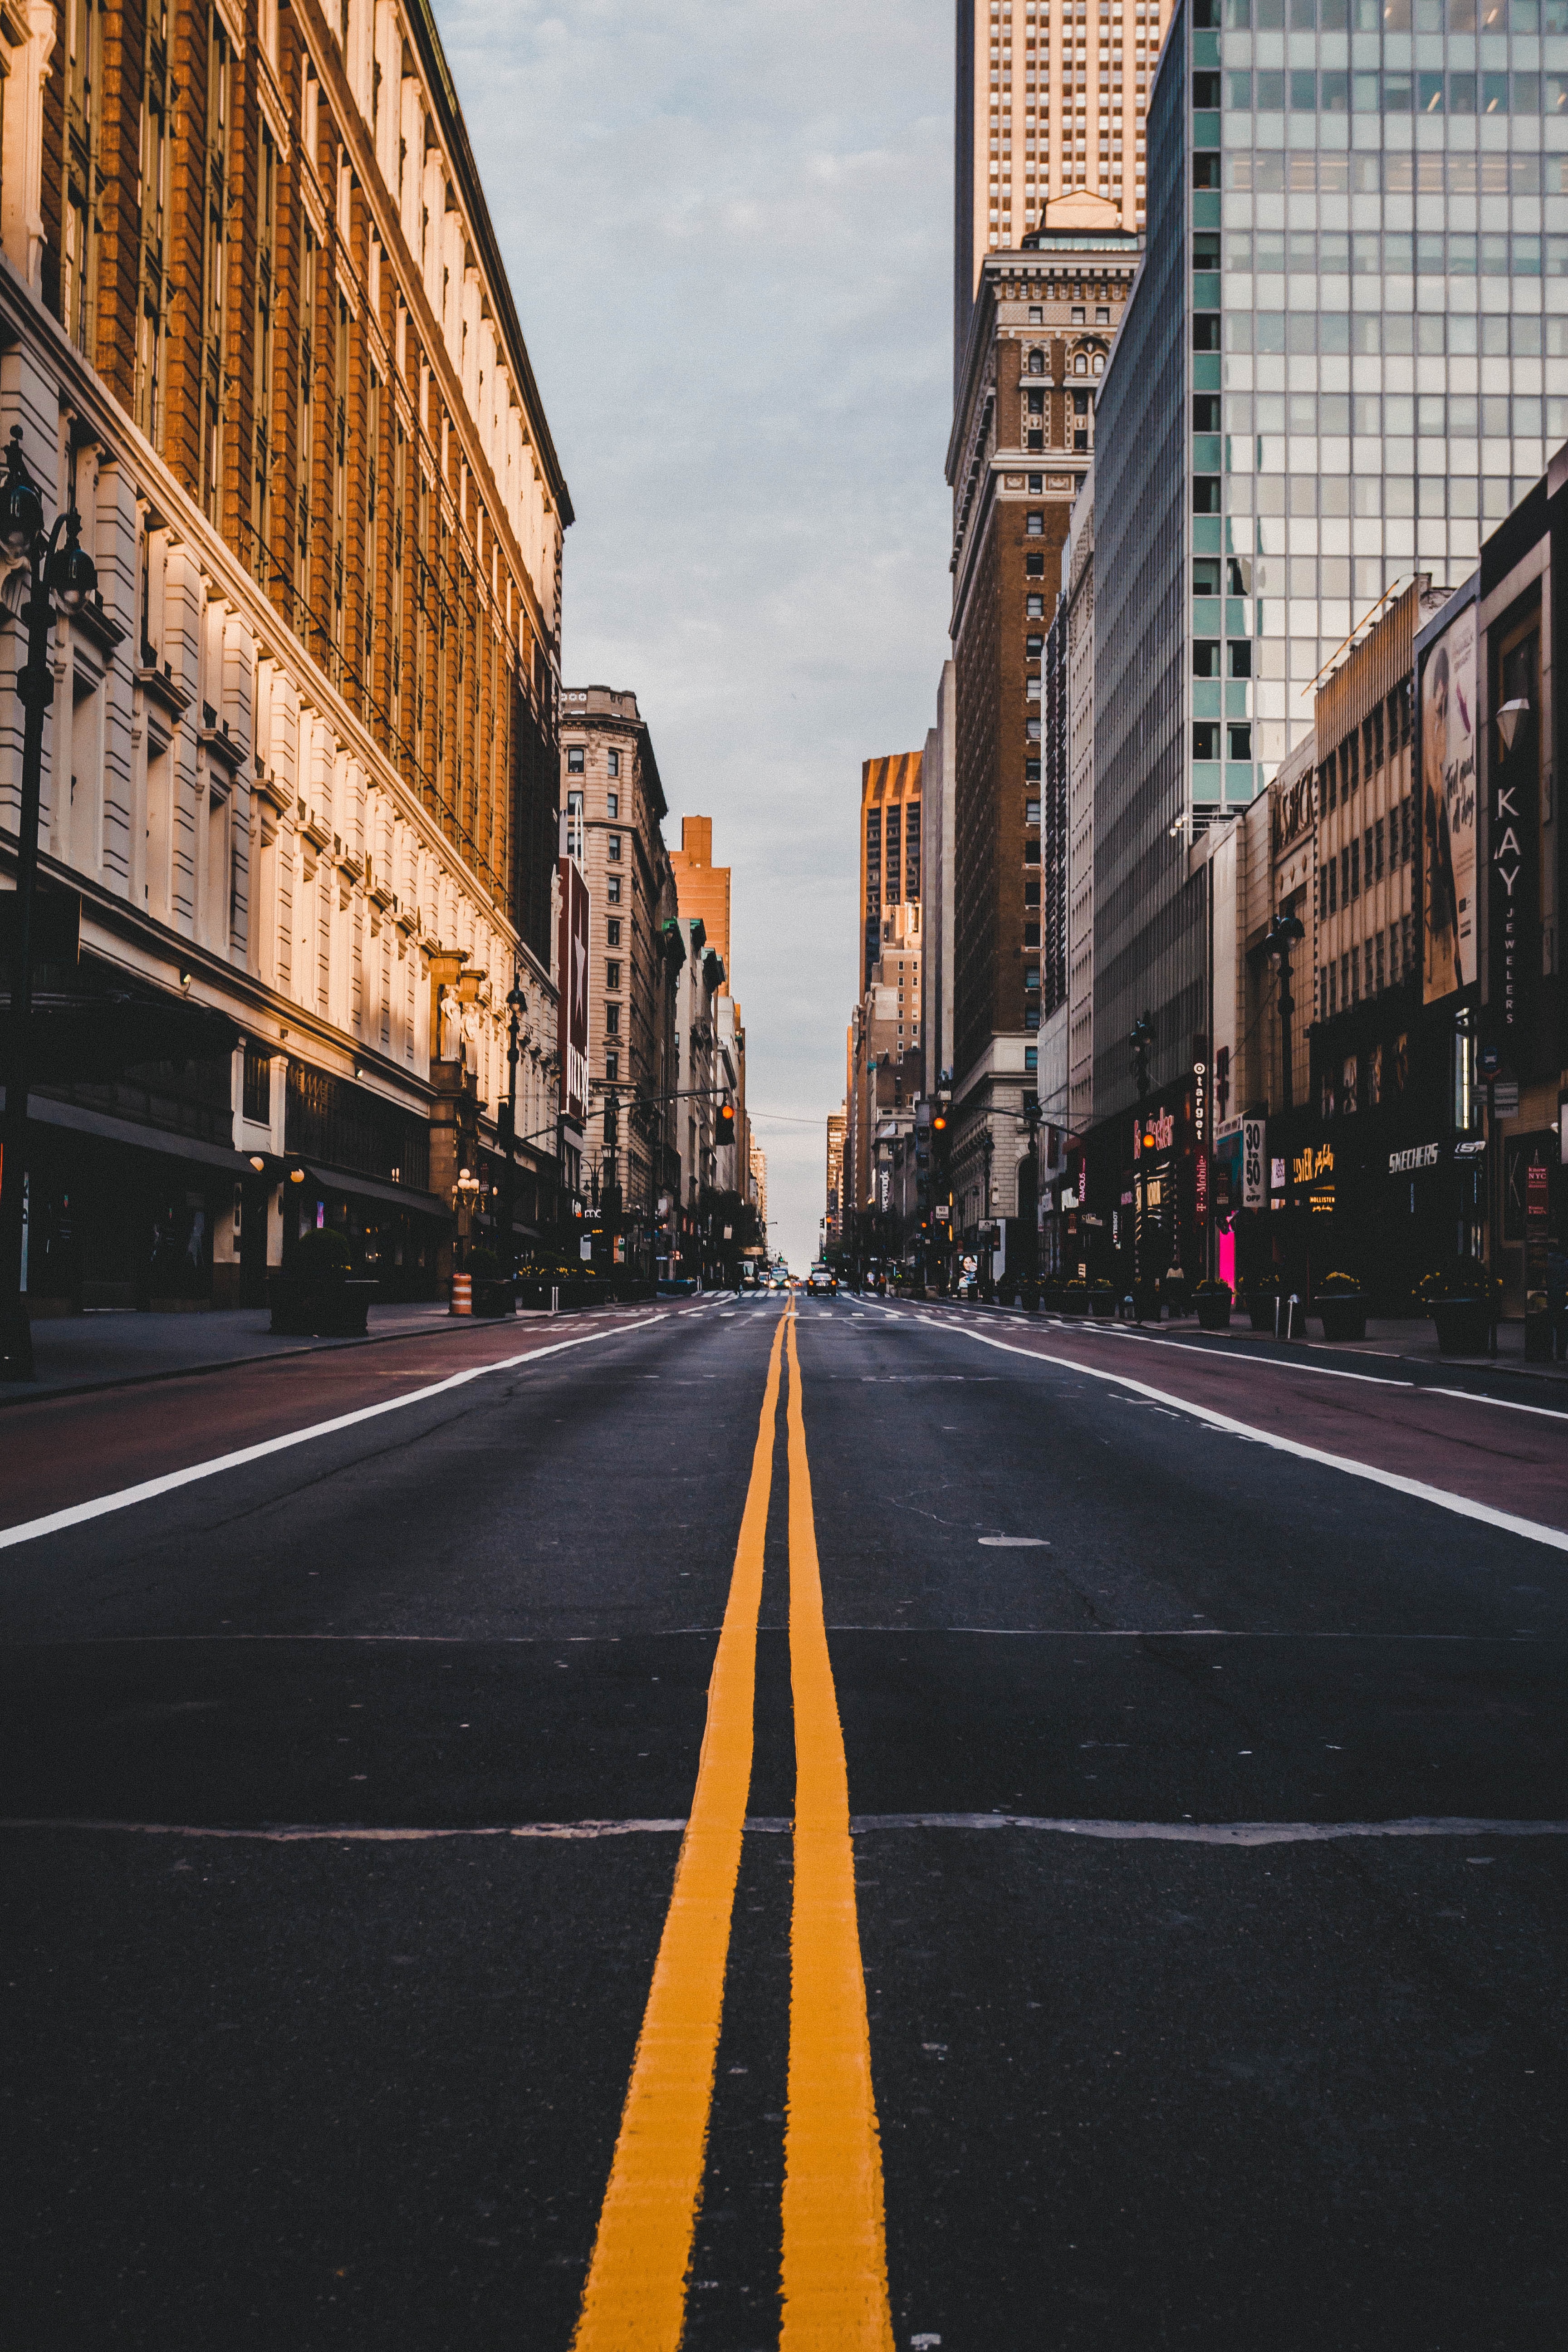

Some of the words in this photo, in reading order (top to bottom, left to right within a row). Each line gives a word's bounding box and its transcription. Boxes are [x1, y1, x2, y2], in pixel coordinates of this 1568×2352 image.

[1497, 787, 1520, 896] KAY
[1505, 907, 1515, 1024] JEWELERS
[1246, 1123, 1260, 1150] 30
[1246, 1160, 1260, 1186] 50
[1389, 1143, 1438, 1174] SKECHERS
